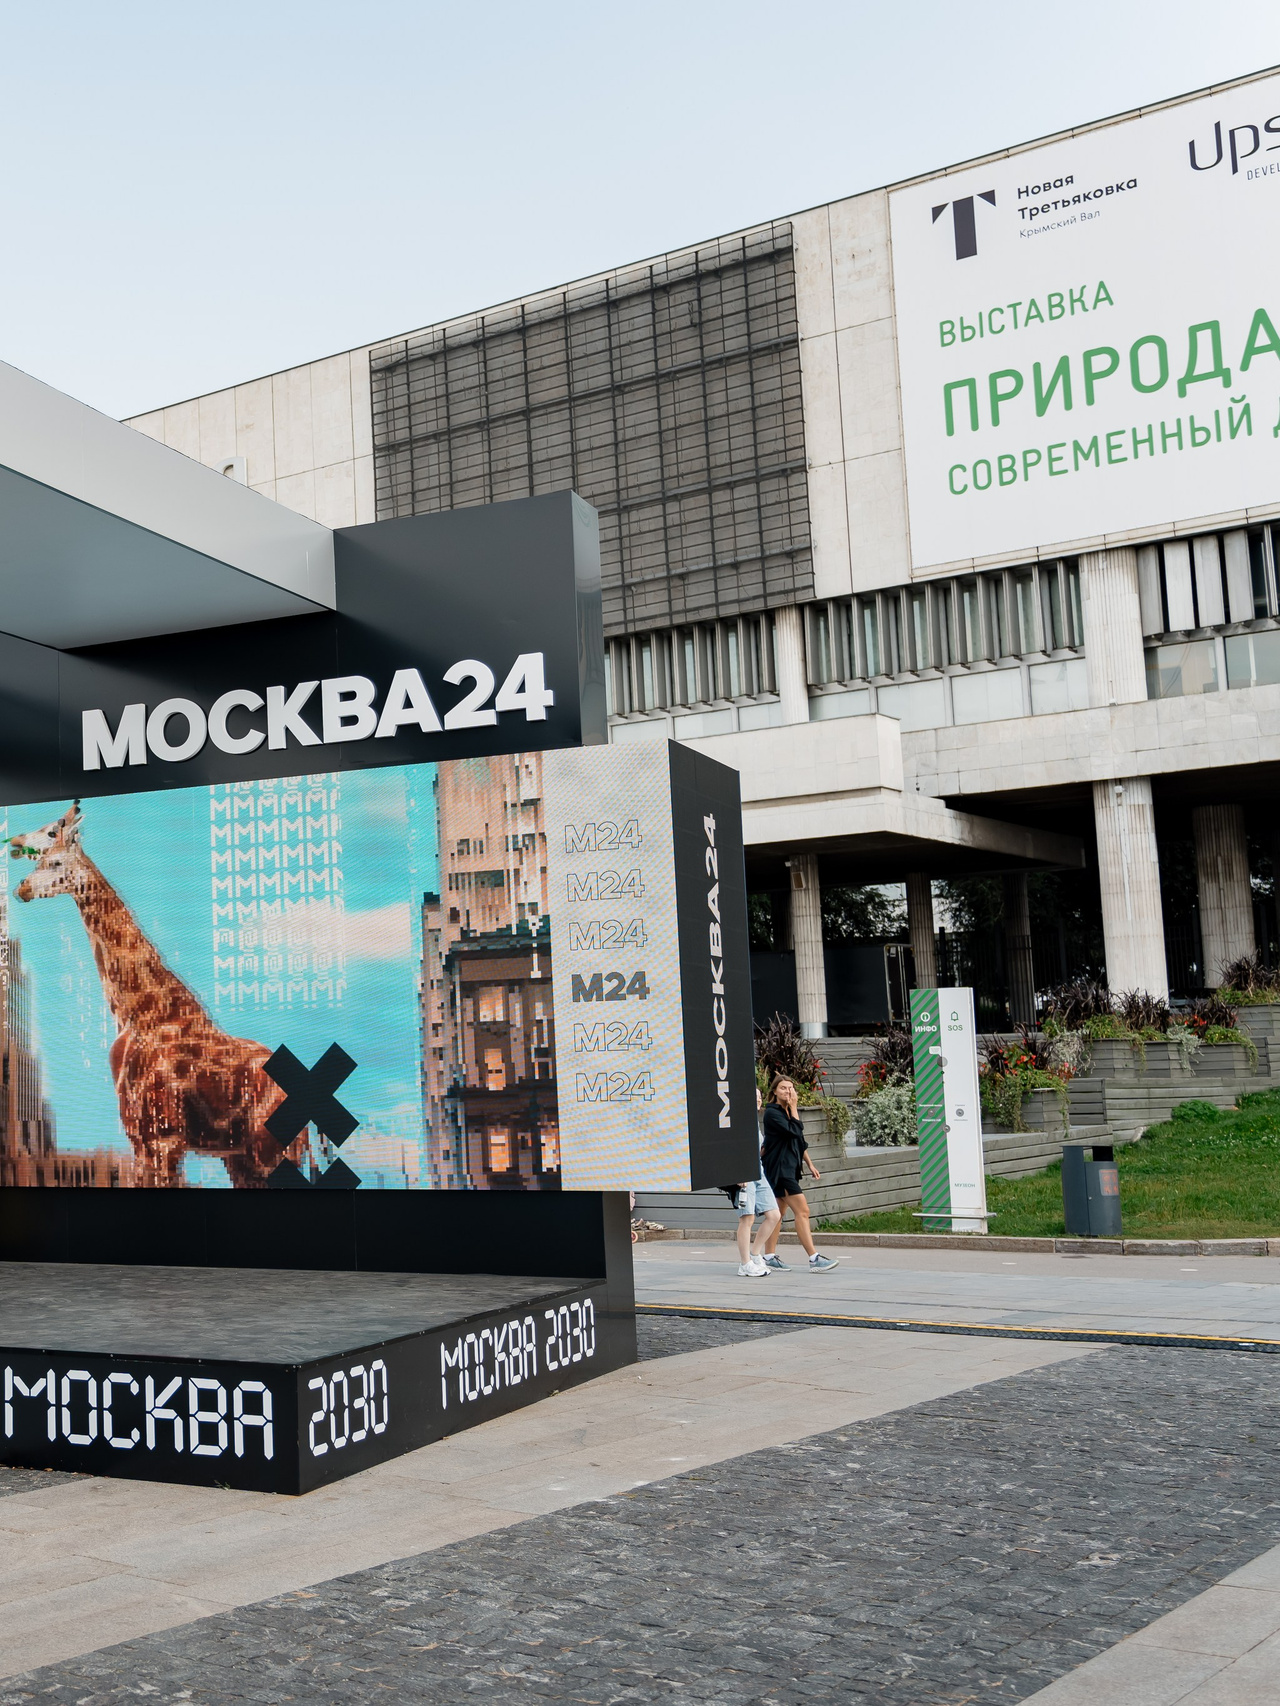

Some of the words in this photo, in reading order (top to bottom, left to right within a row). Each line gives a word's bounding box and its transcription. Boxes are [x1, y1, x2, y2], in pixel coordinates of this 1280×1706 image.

[1017, 174, 1074, 199] Новая
[1017, 178, 1138, 220] Третьяковка
[1019, 215, 1077, 238] Крымский
[1080, 210, 1101, 221] Вал
[939, 280, 1114, 347] ВЫСТАВКА
[943, 307, 1280, 437] ПРИРОДА
[948, 394, 1252, 495] СОВРЕМЕННЫЙ
[81, 651, 554, 771] МОСКВА24
[565, 819, 643, 853] М24
[567, 869, 646, 902] М24
[569, 918, 648, 951] М24
[571, 971, 650, 1002] М24
[703, 813, 731, 1129] МОСКВА24
[573, 1021, 653, 1052] М24
[914, 1025, 938, 1033] ИНФО
[575, 1071, 655, 1102] М24
[439, 1315, 537, 1410] МОСКВА
[544, 1298, 595, 1372] 2030
[4, 1365, 273, 1460] МОСКВА
[308, 1359, 388, 1457] 2030
